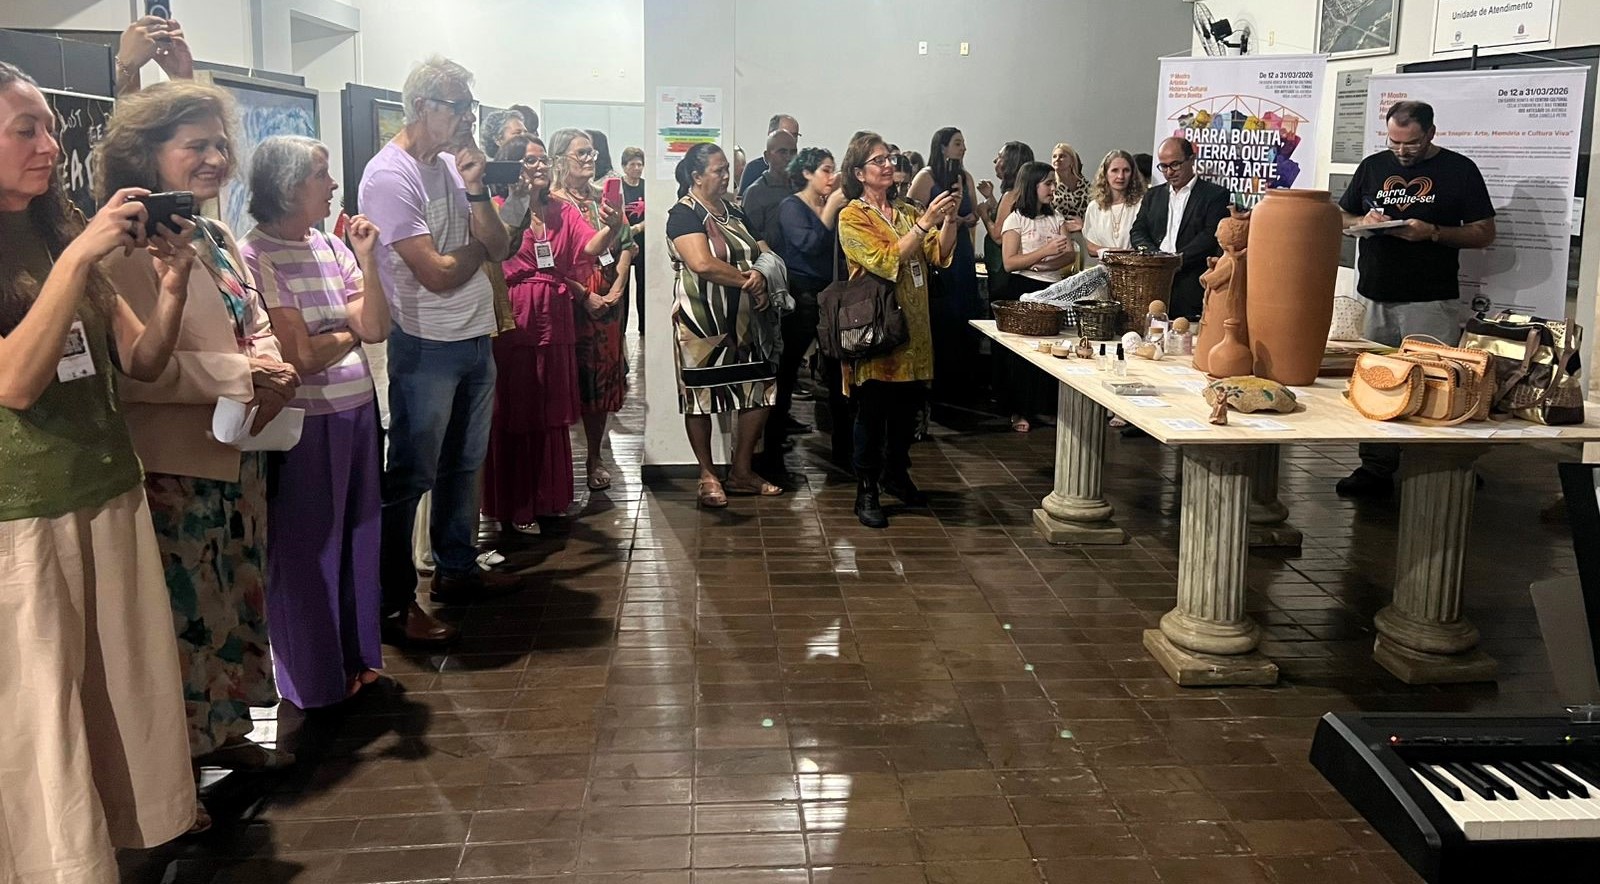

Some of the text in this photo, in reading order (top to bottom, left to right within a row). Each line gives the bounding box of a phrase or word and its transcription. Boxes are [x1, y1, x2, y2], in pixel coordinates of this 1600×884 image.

[1452, 9, 1478, 20] Unidade
[1488, 2, 1533, 14] Atendimento
[1525, 87, 1569, 96] 31/03/2026
[1185, 128, 1284, 148] BARRA BONITA,
[1196, 144, 1269, 161] TERRA QUE
[1243, 161, 1280, 180] ARTE,
[1258, 179, 1266, 193] E
[1376, 189, 1406, 199] Barra
[1383, 194, 1436, 204] Bonite-se!
